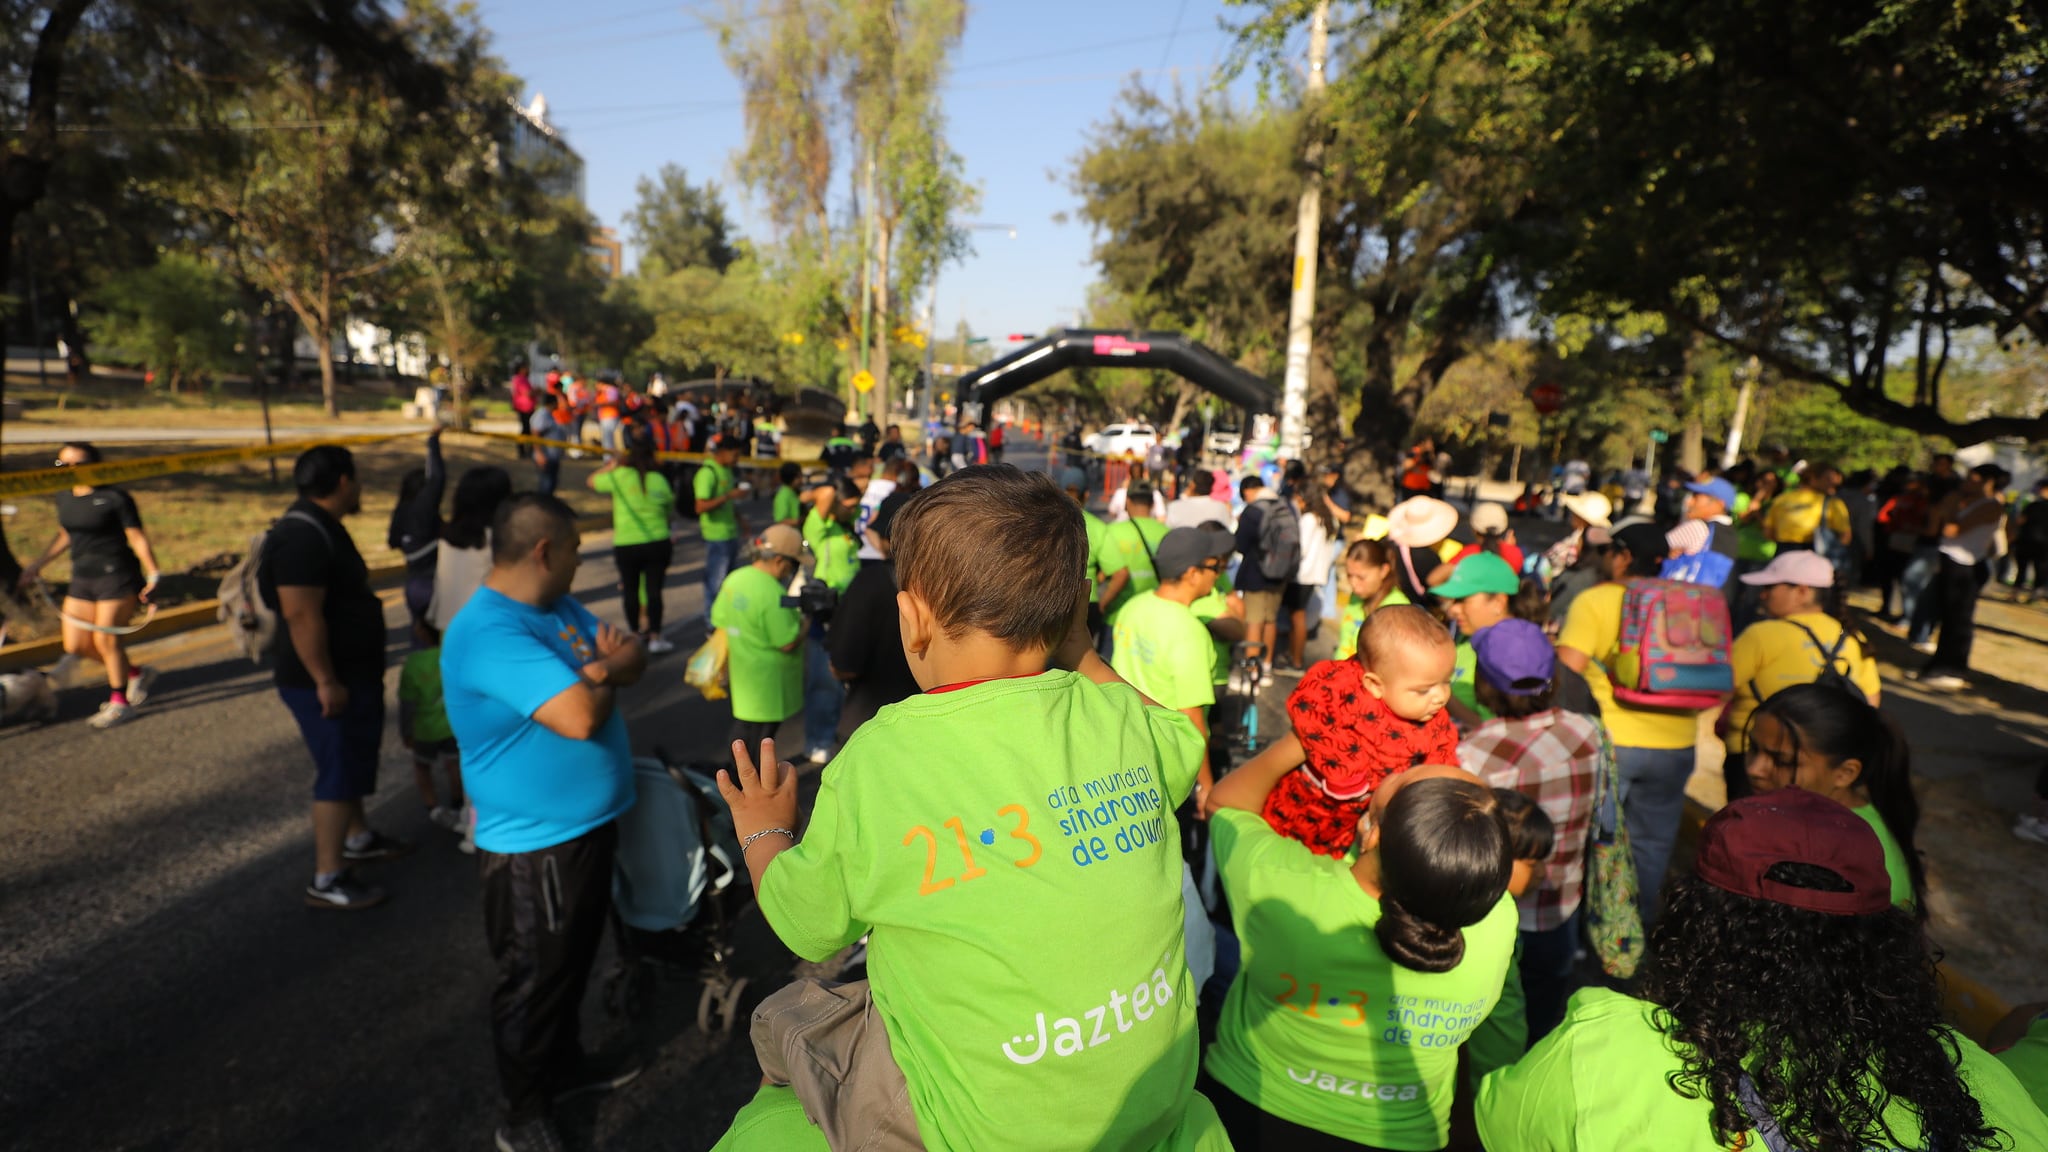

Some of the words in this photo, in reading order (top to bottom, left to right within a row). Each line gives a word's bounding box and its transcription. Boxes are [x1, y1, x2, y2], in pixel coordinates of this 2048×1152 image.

[1047, 785, 1081, 809] día
[1083, 764, 1153, 799] mundial
[1059, 788, 1161, 836] síndrome
[1072, 838, 1109, 867] de
[1114, 816, 1165, 853] down
[1002, 967, 1173, 1065] Jaztea
[1384, 1026, 1412, 1045] de
